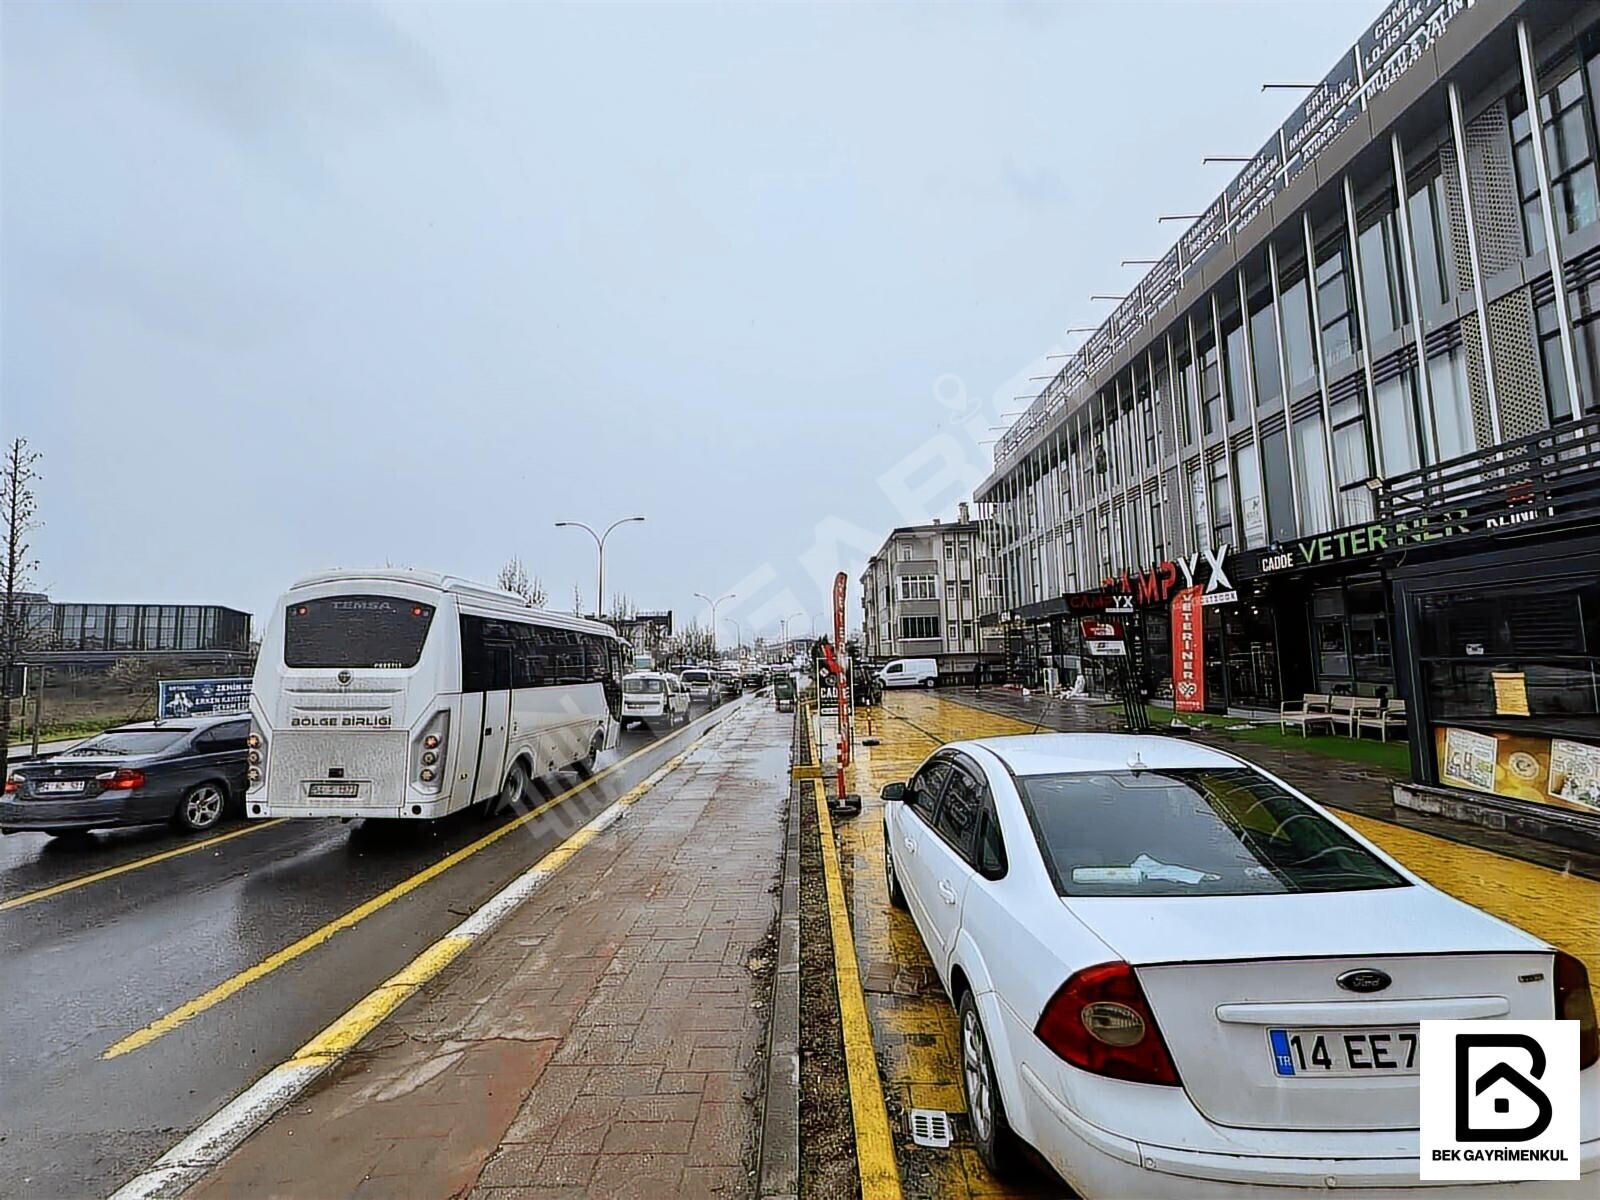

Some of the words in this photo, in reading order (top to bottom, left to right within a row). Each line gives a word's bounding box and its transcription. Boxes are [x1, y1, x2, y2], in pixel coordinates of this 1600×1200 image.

[1365, 0, 1423, 70] LOJİSTİK
[1366, 49, 1408, 101] MUTLU
[1288, 77, 1353, 152] MADENCİLİK
[1302, 119, 1340, 163] AVUKAT
[1261, 553, 1293, 573] CADDE
[333, 602, 391, 610] TEMSA
[291, 717, 337, 726] BÖLGE
[342, 714, 392, 726] BİRLİĞİ
[1277, 1055, 1292, 1067] TR
[1291, 1034, 1333, 1070] 14
